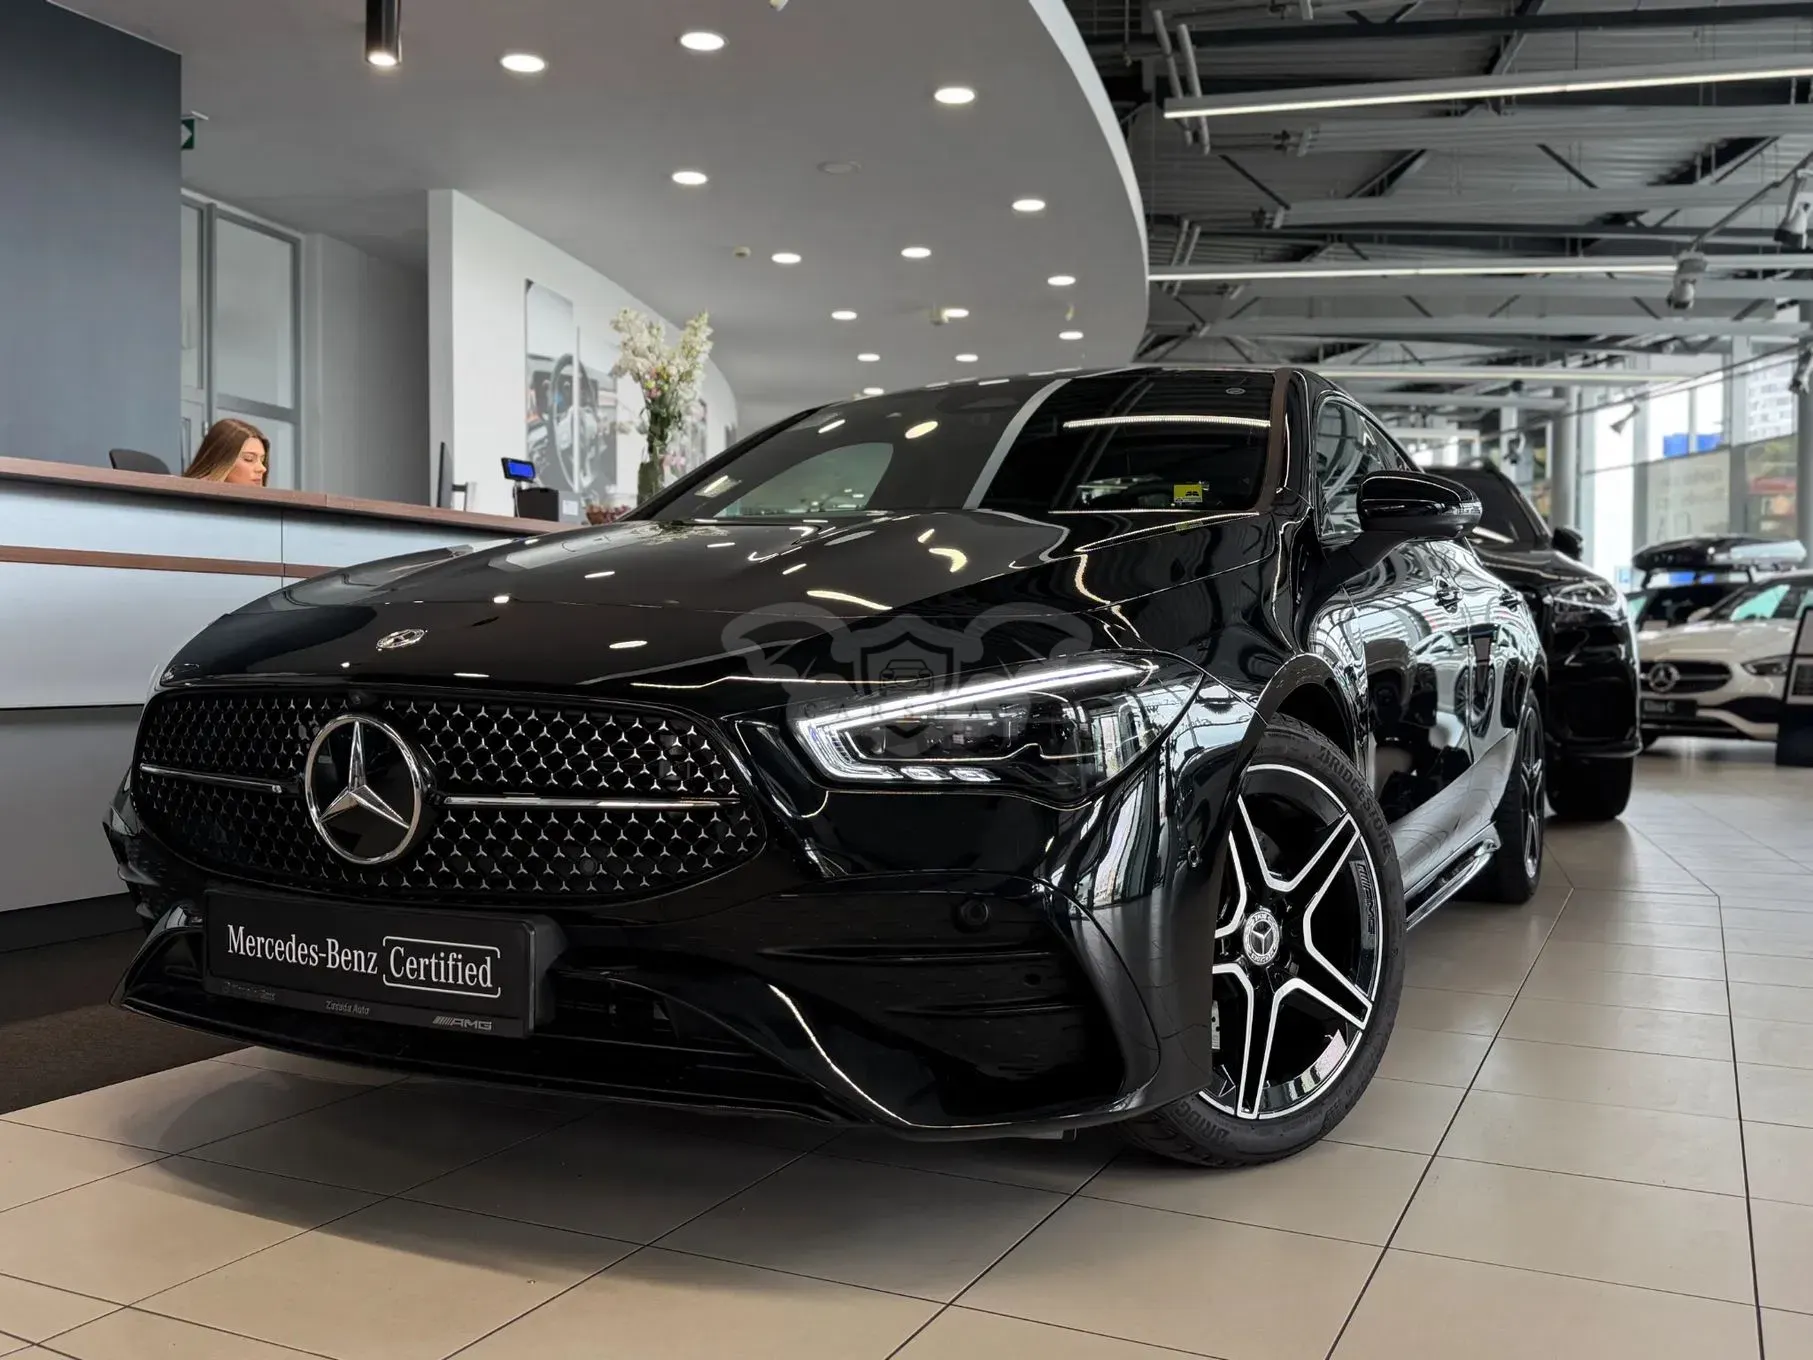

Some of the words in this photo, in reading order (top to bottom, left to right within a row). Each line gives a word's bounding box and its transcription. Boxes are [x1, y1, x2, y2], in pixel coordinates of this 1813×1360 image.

[227, 924, 378, 975] Mercedes-Benz
[389, 945, 494, 988] Certified
[448, 1016, 493, 1031] AMG
